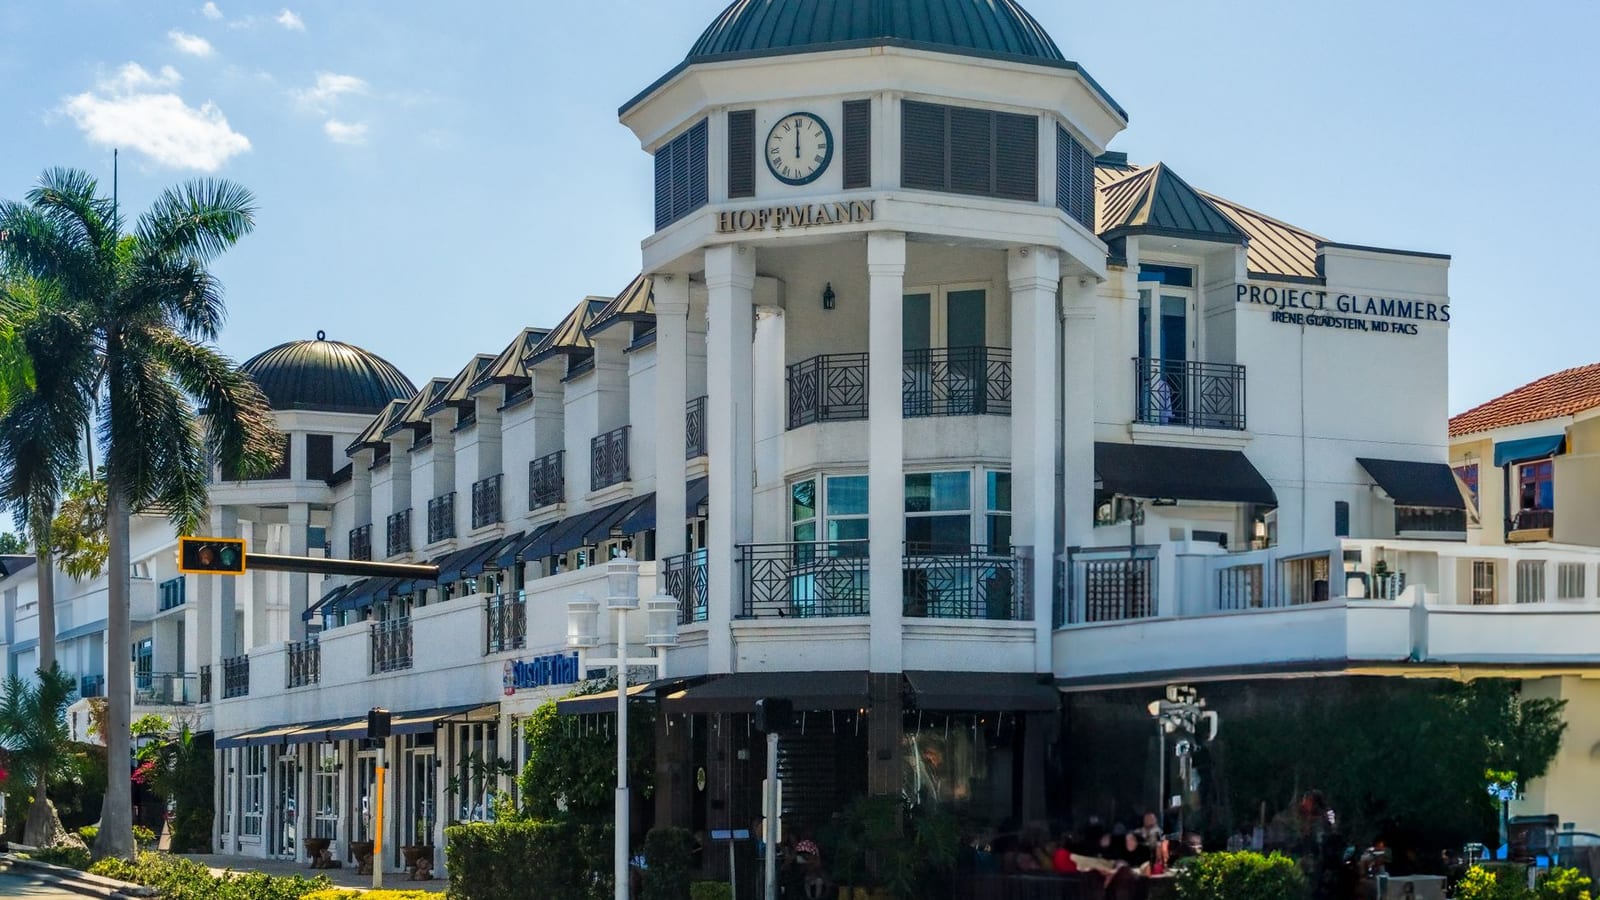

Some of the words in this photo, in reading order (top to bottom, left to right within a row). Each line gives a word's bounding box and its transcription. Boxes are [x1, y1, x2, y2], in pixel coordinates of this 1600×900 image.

[715, 199, 875, 233] HOFFMANN
[1236, 284, 1327, 310] PROJECT
[1337, 294, 1451, 322] GLAMMERS
[1271, 311, 1304, 325] IRENE
[1371, 320, 1389, 333] MD
[1392, 322, 1418, 335] FACS
